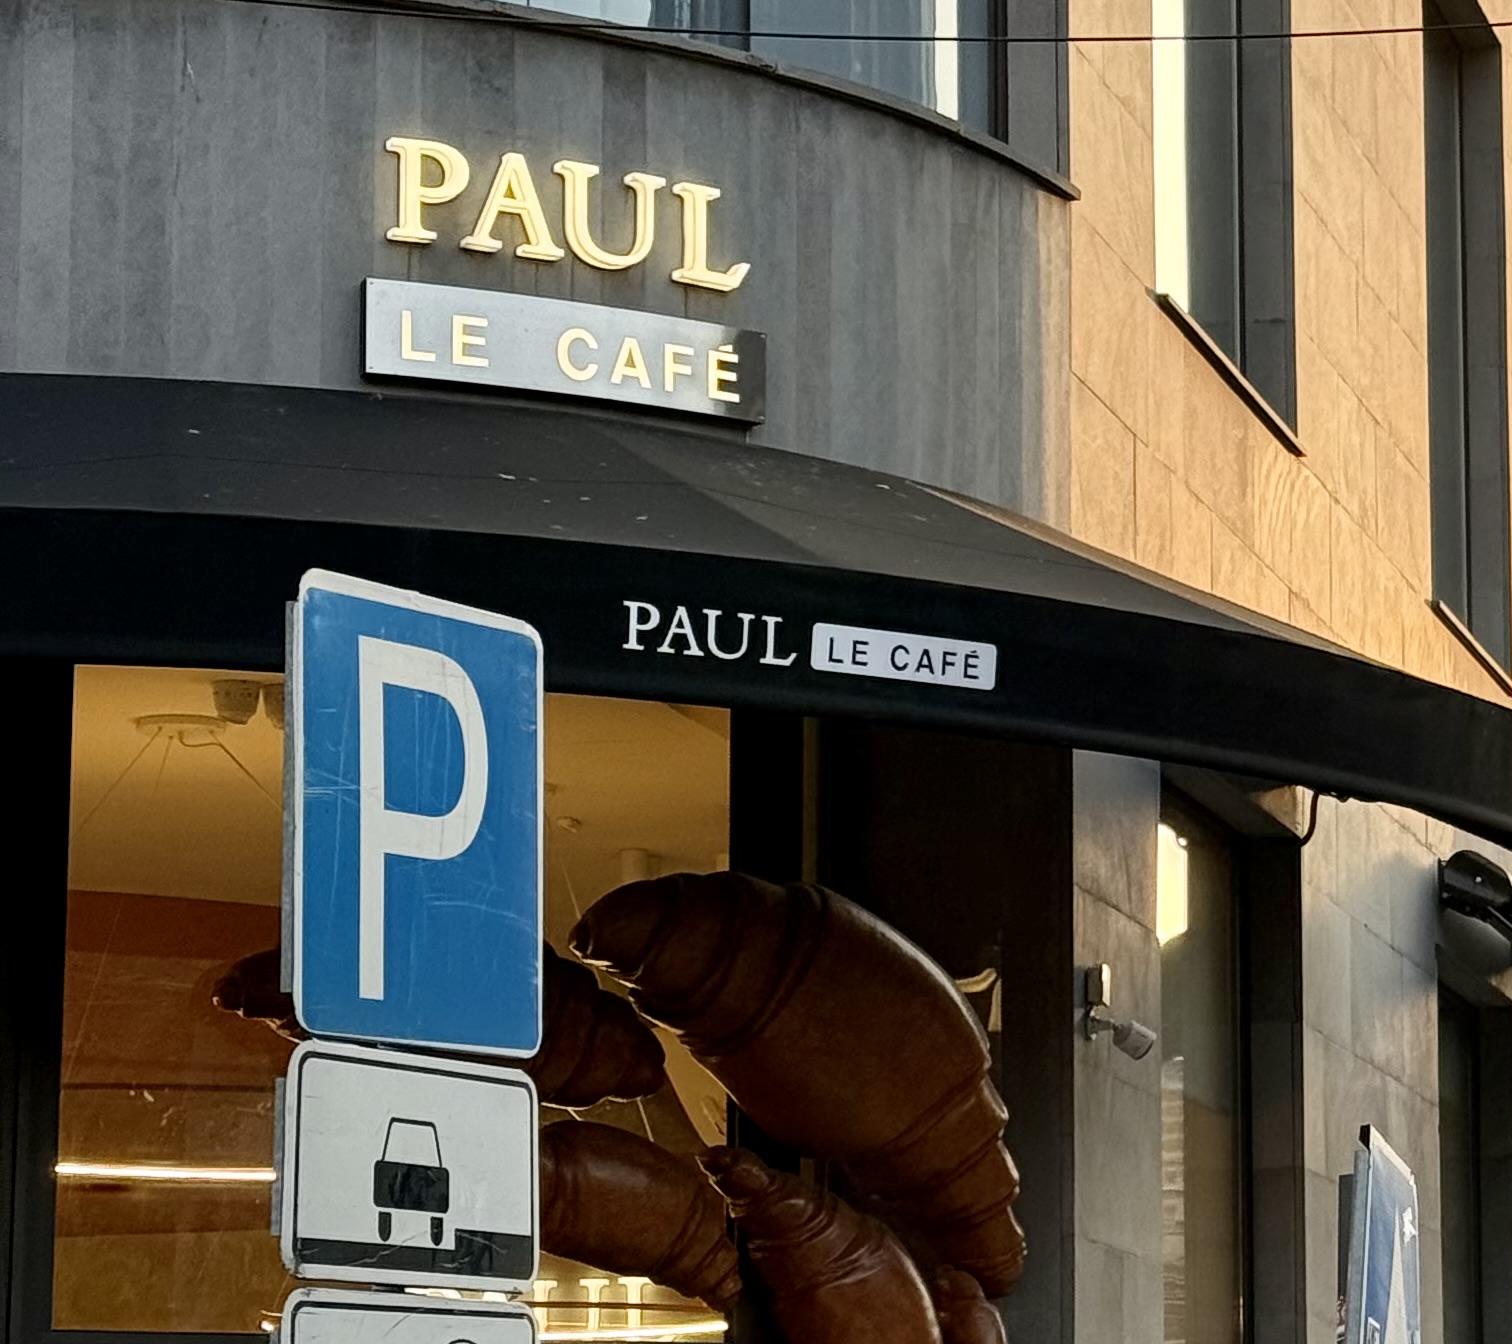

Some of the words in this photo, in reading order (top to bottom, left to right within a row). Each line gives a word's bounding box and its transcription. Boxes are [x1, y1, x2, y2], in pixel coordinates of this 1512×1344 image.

[384, 136, 751, 292] PAUL
[400, 309, 489, 368] LE
[556, 327, 742, 404] CAFÉ
[622, 600, 798, 667] PAUL
[827, 636, 870, 667] LE
[889, 645, 981, 681] CAFÉ
[358, 635, 489, 1001] P
